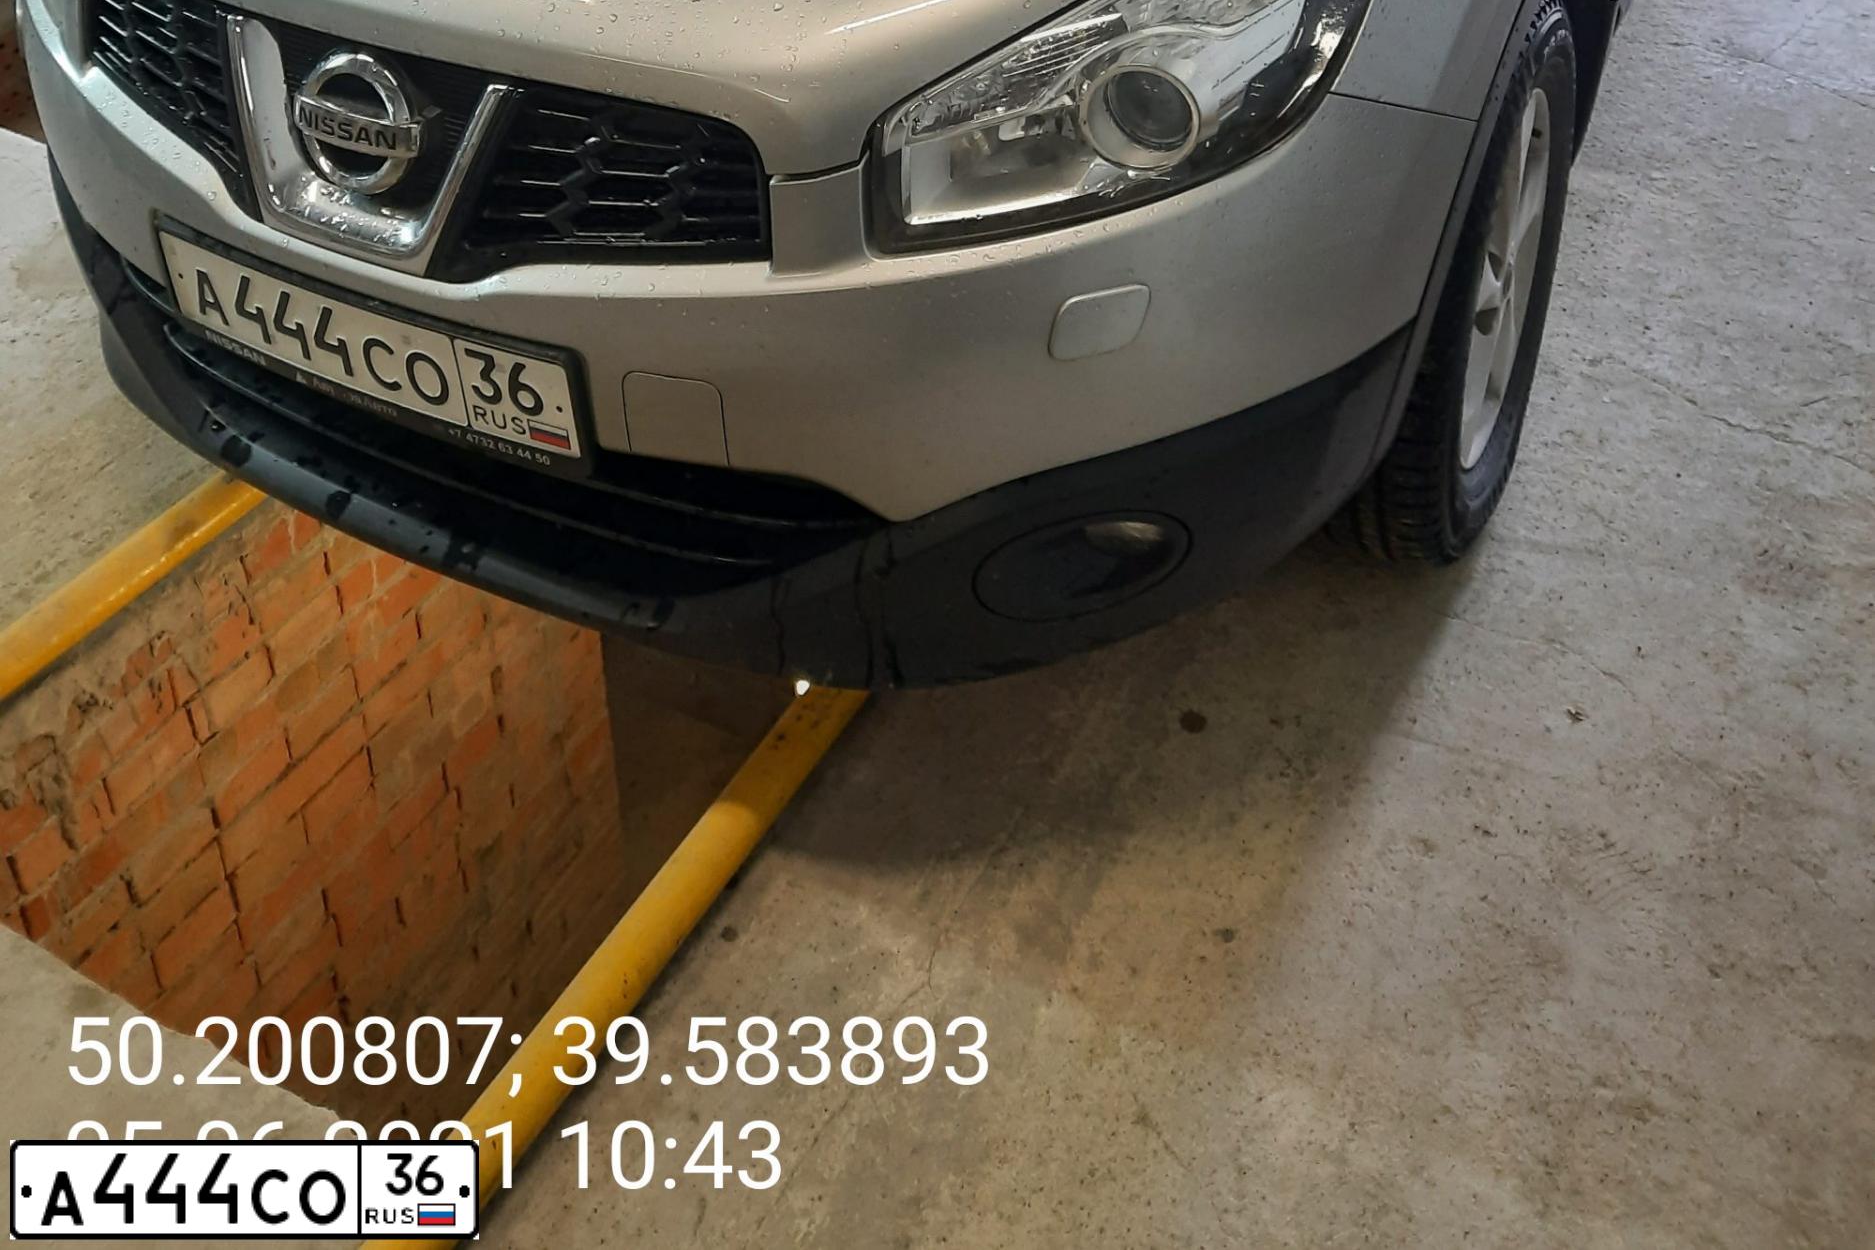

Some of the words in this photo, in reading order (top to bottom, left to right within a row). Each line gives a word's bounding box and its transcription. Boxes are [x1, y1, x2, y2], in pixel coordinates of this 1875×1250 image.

[299, 106, 397, 151] NISSAN
[195, 268, 450, 407] A444CO
[463, 347, 545, 417] 36
[205, 328, 268, 367] NISSAN
[472, 404, 527, 436] RUS
